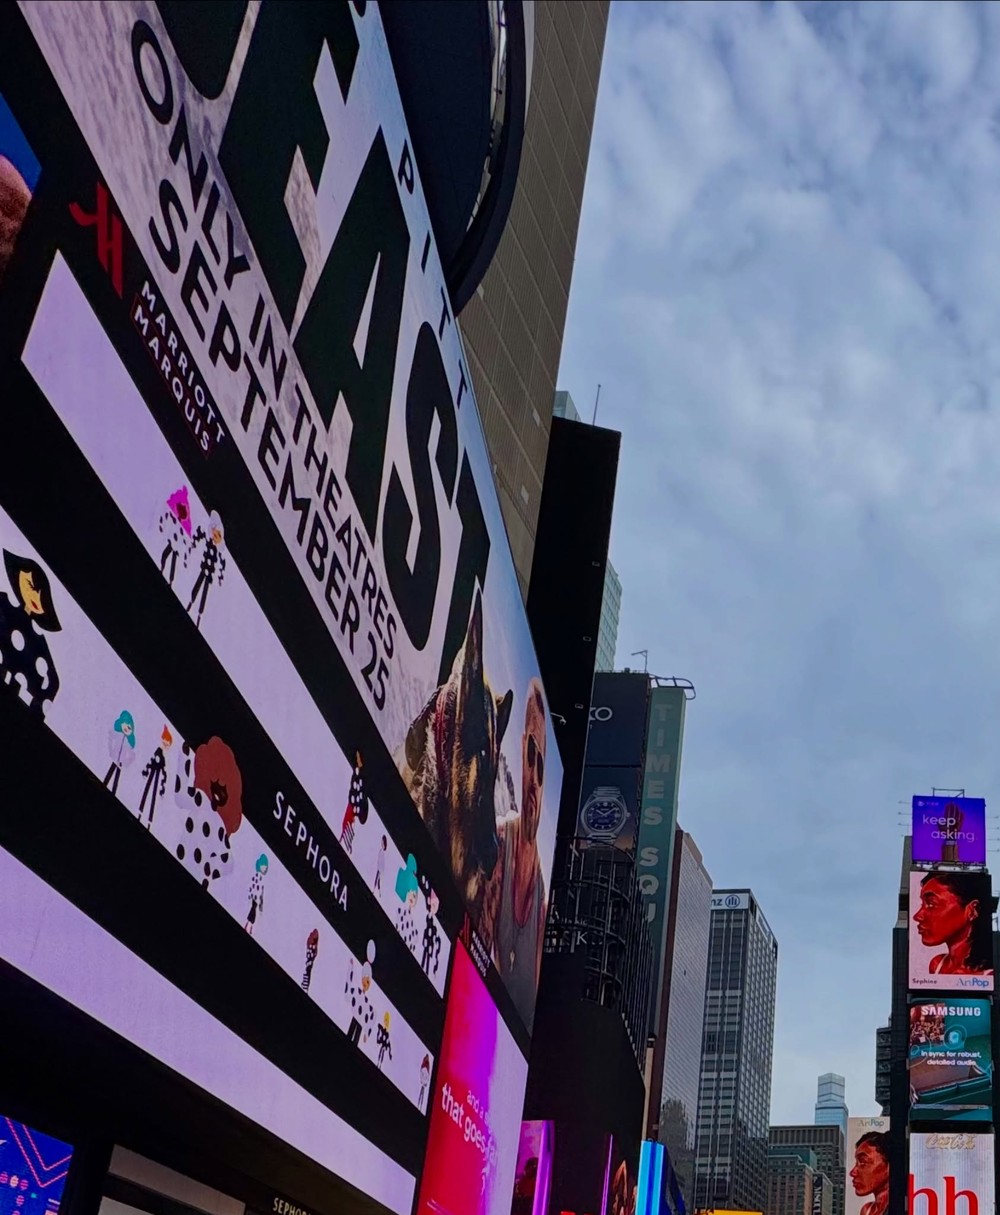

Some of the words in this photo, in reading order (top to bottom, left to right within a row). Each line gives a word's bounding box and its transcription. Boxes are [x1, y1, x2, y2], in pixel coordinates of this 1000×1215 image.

[398, 139, 468, 410] PITT
[131, 20, 251, 290] ONLY
[249, 294, 287, 400] IN
[293, 384, 397, 660] THEATRES
[134, 303, 210, 452] MARQUIS
[141, 280, 225, 444] MARRIOTT
[149, 179, 360, 655] SEPTEMBER
[360, 634, 389, 711] 25
[643, 703, 672, 826] TIMES
[922, 814, 956, 828] keep
[273, 791, 348, 912] SEPHORA
[930, 828, 975, 843] asking
[921, 1006, 981, 1017] SAMSUNG
[441, 1082, 464, 1128] that
